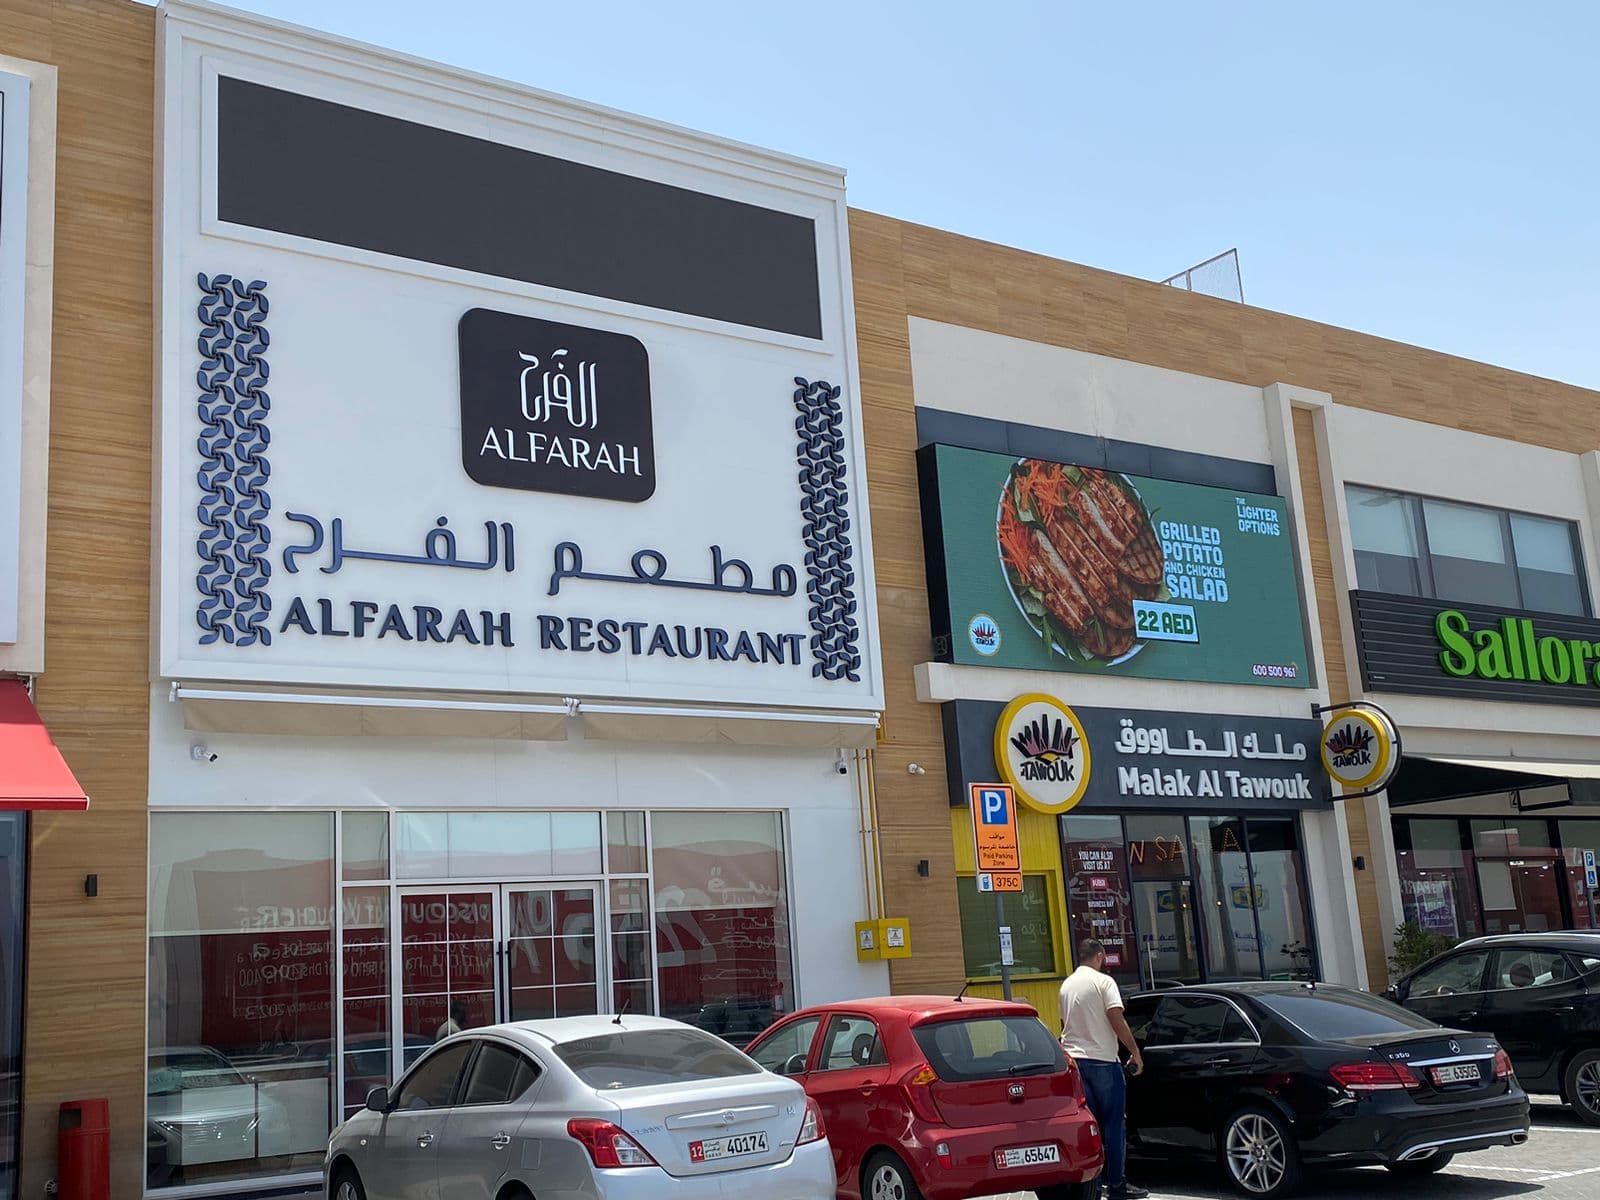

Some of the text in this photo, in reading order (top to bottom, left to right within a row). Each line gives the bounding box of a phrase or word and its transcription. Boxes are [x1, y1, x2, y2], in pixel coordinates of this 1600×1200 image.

[479, 427, 642, 476] ALFARAH
[1235, 497, 1246, 505] THE
[1236, 505, 1278, 522] LIGHTER
[1160, 521, 1220, 545] GRILLED
[1238, 520, 1280, 536] OPTIONS
[283, 511, 798, 598] مطعم الفرح
[1162, 540, 1223, 566] POTATO
[1164, 561, 1226, 579] AND CHICKEN
[1165, 574, 1229, 603] SALAD
[279, 596, 807, 666] ALFARAH RESTAURANT
[1137, 609, 1194, 635] 22 AED
[1435, 610, 1600, 688] Sallor
[1252, 664, 1297, 679] 600 500 961
[1114, 717, 1307, 761] ملك الطاووق
[1117, 766, 1312, 800] Malak Al Tawouk
[984, 791, 1002, 824] P
[1078, 851, 1113, 860] YOU CAN ALSO
[1083, 861, 1111, 870] VISIT US AT
[996, 877, 1018, 888] 375C
[1453, 1065, 1479, 1080] 63505
[1011, 1086, 1024, 1095] KIA
[691, 1146, 703, 1158] 12
[726, 1135, 766, 1155] 40174
[1024, 1146, 1056, 1163] 65647
